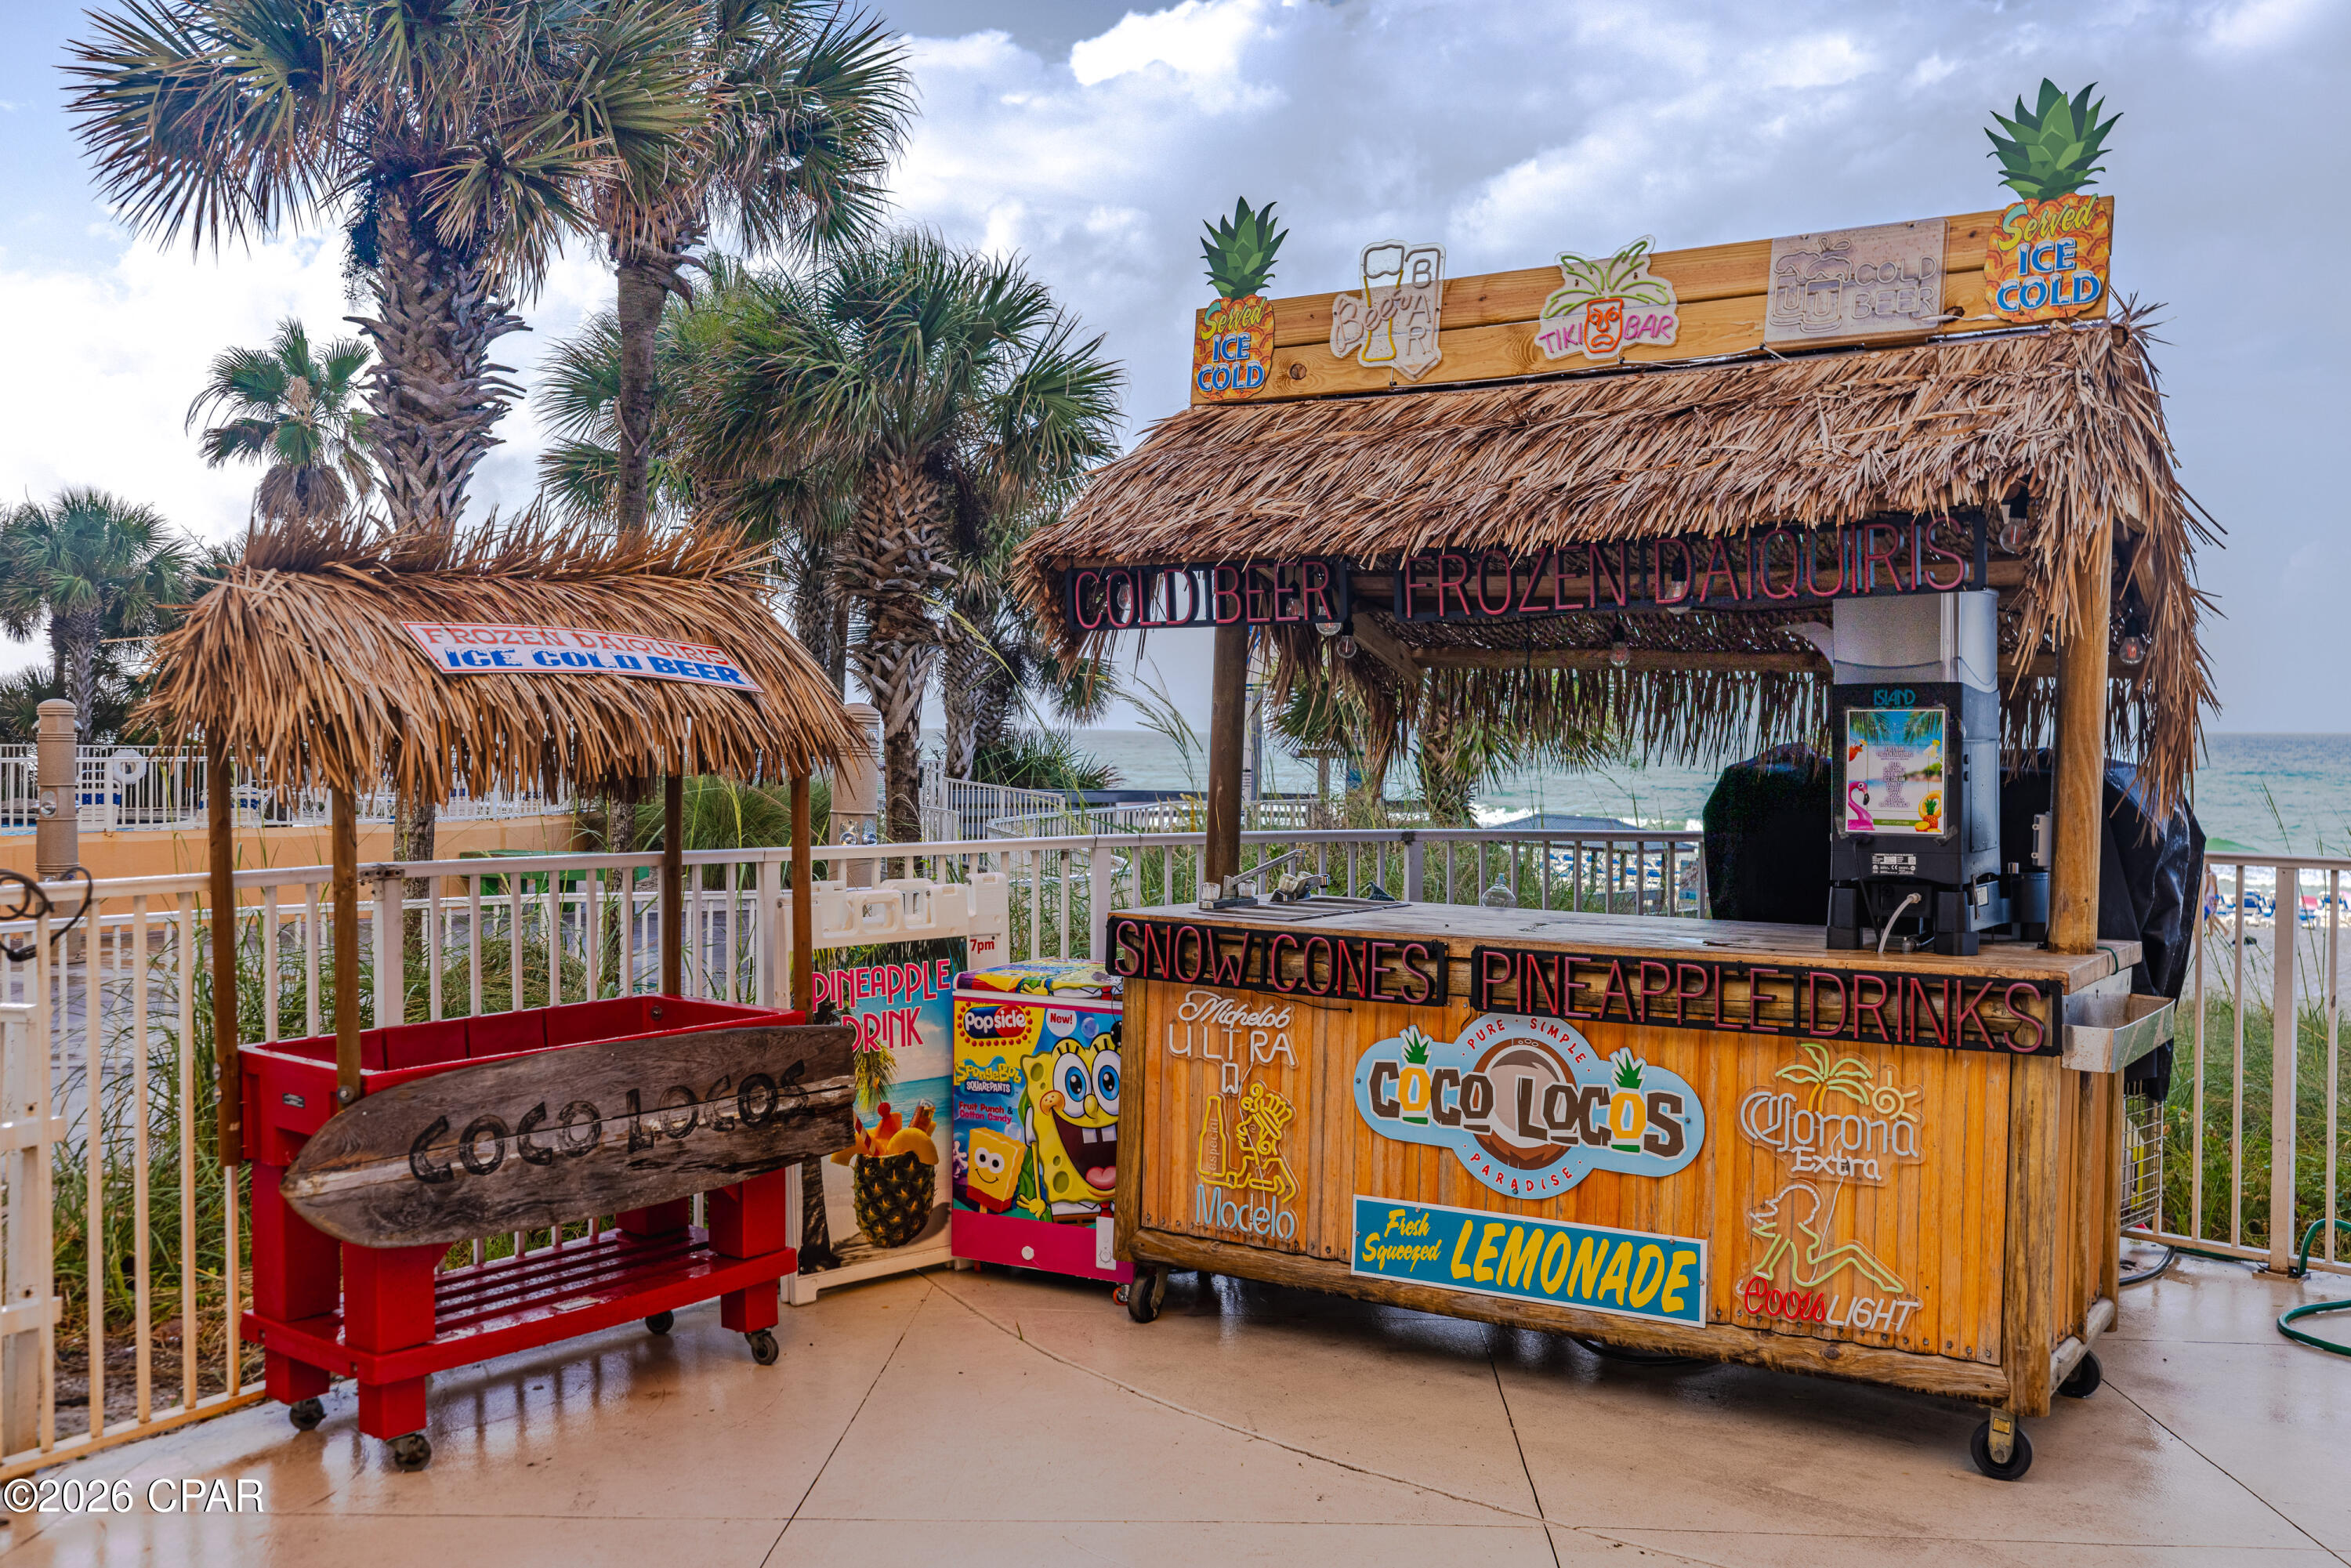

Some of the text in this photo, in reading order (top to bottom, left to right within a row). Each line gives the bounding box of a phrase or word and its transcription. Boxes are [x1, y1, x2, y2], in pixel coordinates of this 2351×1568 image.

[1998, 194, 2099, 251] Served
[1854, 255, 1937, 287] COLD
[2018, 237, 2078, 277] ICE
[1851, 287, 1935, 320] BEER
[1996, 270, 2101, 313] COLD
[1201, 296, 1267, 340] Served
[1335, 289, 1412, 352] Beer
[1538, 313, 1674, 353] TIKI BAR
[1212, 333, 1251, 362] ICE
[1197, 360, 1266, 393] COLD
[1405, 516, 1968, 618] FROZEN DAIQUIRIS
[1074, 560, 1334, 630] COLD BEER
[426, 627, 731, 665] FROZEN DAIQUIRIS
[445, 646, 745, 686] ICE COLD BEER
[1874, 689, 1916, 705] ISLAND
[969, 939, 995, 954] 7pm
[1114, 920, 1431, 1004] SNOW CONES
[812, 958, 951, 1013] PINEAPPLE
[1482, 950, 2045, 1053] PINEAPPLE DRINKS
[841, 1006, 924, 1053] DRINK
[964, 1009, 1027, 1034] Popsicle
[1050, 1012, 1073, 1024] New!
[1178, 990, 1292, 1030] Michelob
[1168, 1023, 1295, 1066] ULTRA
[1467, 1017, 1587, 1064] PURE SIMPLE
[965, 1081, 1011, 1093] SQUAREPANTS
[408, 1060, 812, 1185] COCO LOCOS
[958, 1101, 1013, 1114] Fruit Punch &
[959, 1109, 1012, 1124] Cotton Candy
[1369, 1060, 1686, 1158] COCO LOCOS
[1741, 1091, 1919, 1157] Corona
[1208, 1117, 1219, 1174] especial
[1791, 1146, 1882, 1181] Extra
[1470, 1152, 1573, 1193] PARADISE
[1196, 1184, 1295, 1240] Modelo
[1384, 1209, 1430, 1238] Fresh
[1362, 1233, 1442, 1272] Squeezed
[1451, 1219, 1697, 1313] LEMONADE
[1827, 1295, 1920, 1331] LIGHT
